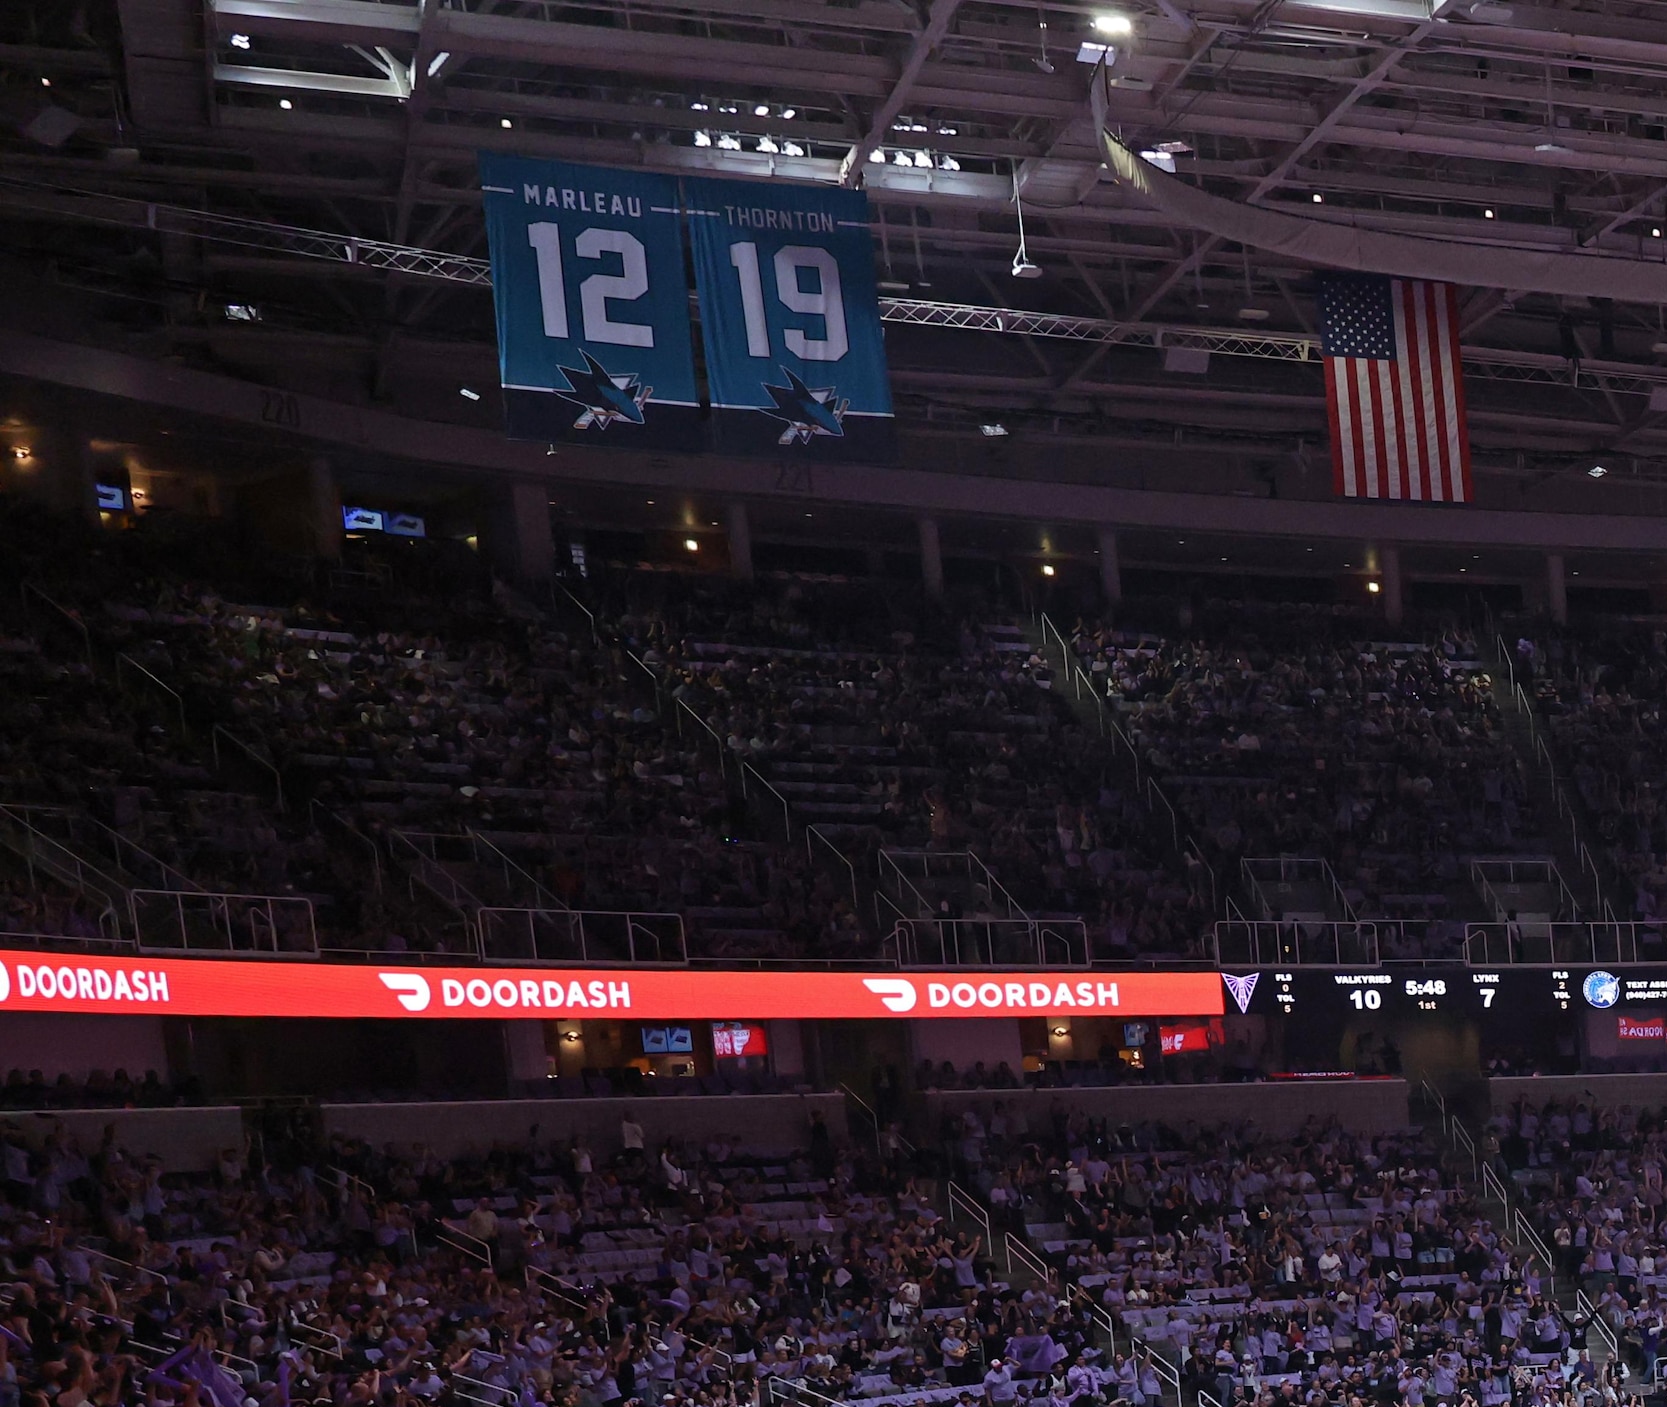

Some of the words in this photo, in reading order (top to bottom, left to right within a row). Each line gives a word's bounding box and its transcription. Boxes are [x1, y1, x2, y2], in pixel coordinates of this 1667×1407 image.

[523, 183, 641, 218] MARLEAU
[724, 205, 835, 233] THORNTON
[527, 221, 655, 349] 12
[729, 241, 850, 362] 19
[1275, 973, 1293, 982] FLS
[1335, 975, 1392, 986] VALKYRIES
[1473, 974, 1500, 983] LYNX
[1552, 971, 1569, 980] FLS
[17, 963, 170, 1003] DOORDASH
[1282, 984, 1290, 992] 0
[1405, 980, 1447, 996] 5:48
[1558, 981, 1566, 990] 2
[1626, 981, 1648, 989] TEXT
[442, 977, 632, 1009] DOORDASH
[927, 981, 1120, 1009] DOORDASH
[1480, 988, 1496, 1008] 7
[1553, 991, 1571, 1000] TOL
[1277, 994, 1295, 1003] TOL
[1349, 989, 1381, 1010] 10
[1284, 1004, 1292, 1013] 5
[1418, 1000, 1436, 1010] 1st
[1561, 1000, 1568, 1010] 5
